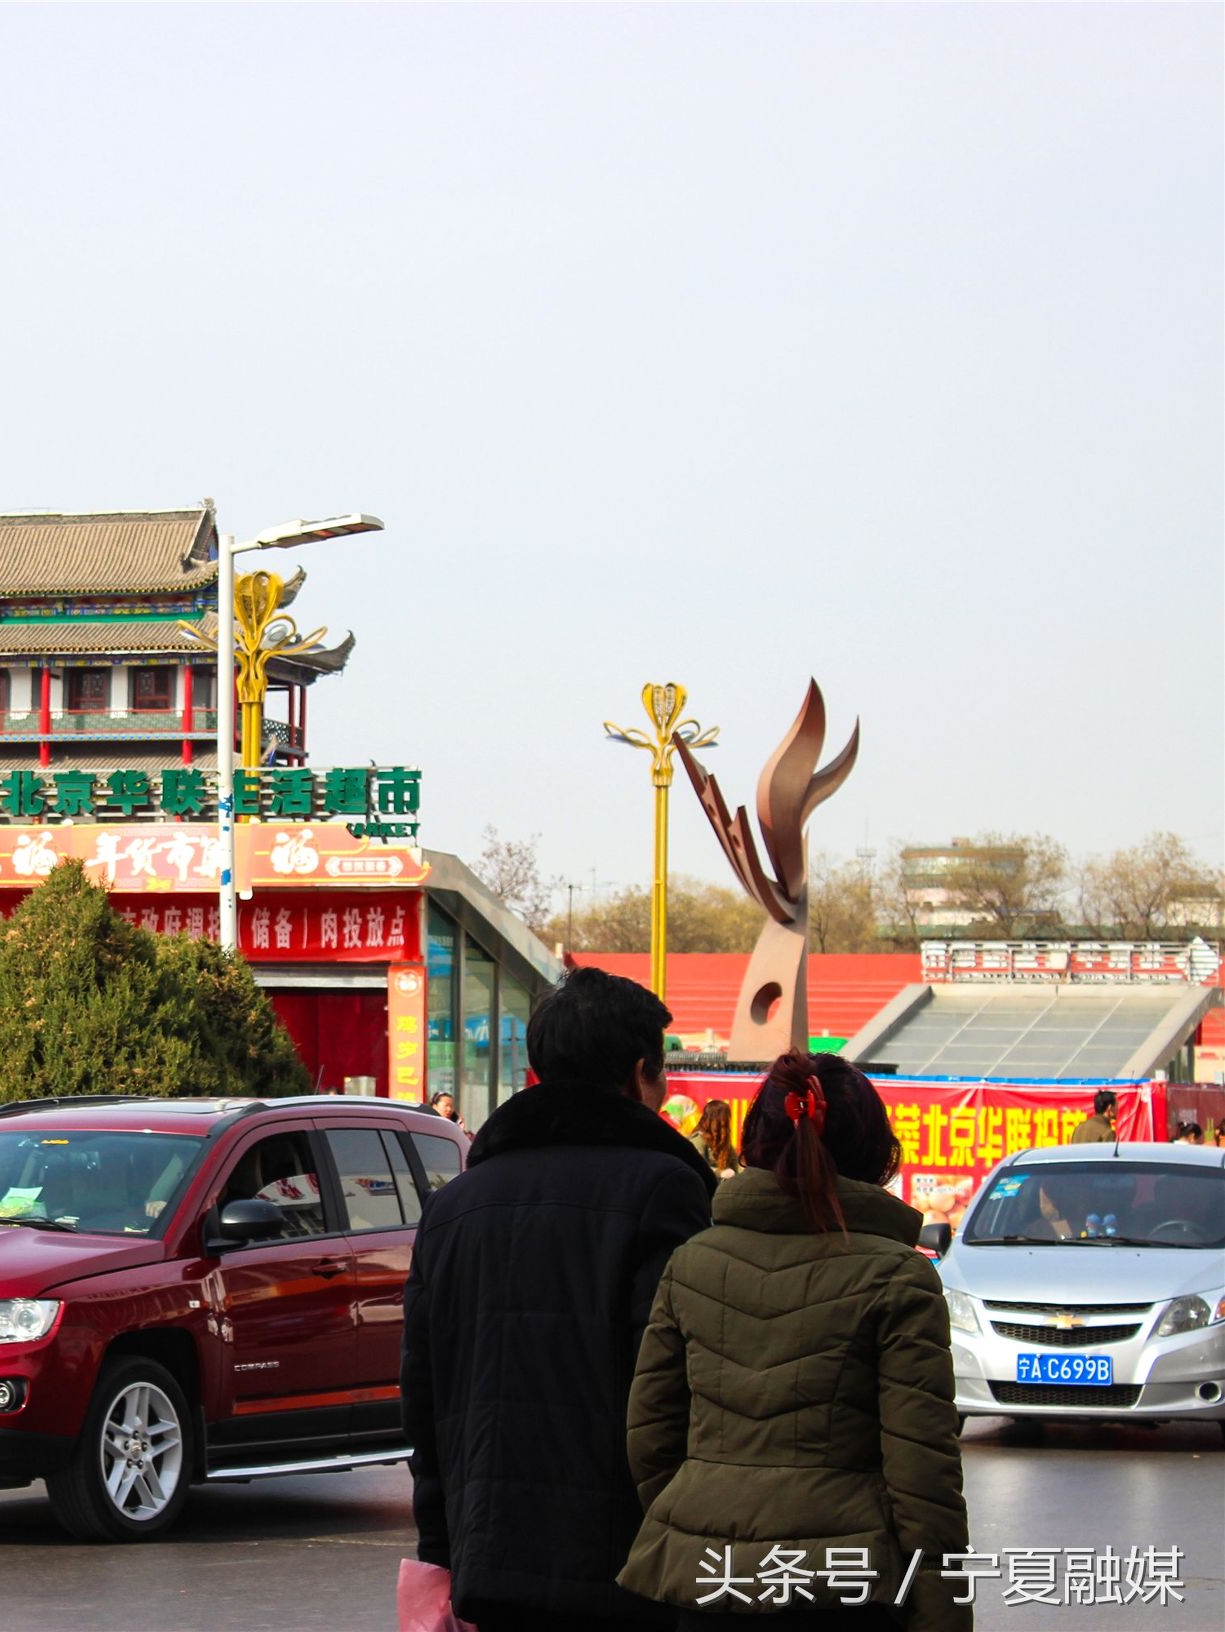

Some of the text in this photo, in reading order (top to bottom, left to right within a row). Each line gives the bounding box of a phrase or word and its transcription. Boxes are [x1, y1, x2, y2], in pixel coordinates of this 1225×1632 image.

[2, 767, 422, 816] 北京华联生活超市
[271, 829, 318, 874] 福
[234, 1361, 280, 1372] COMPASS
